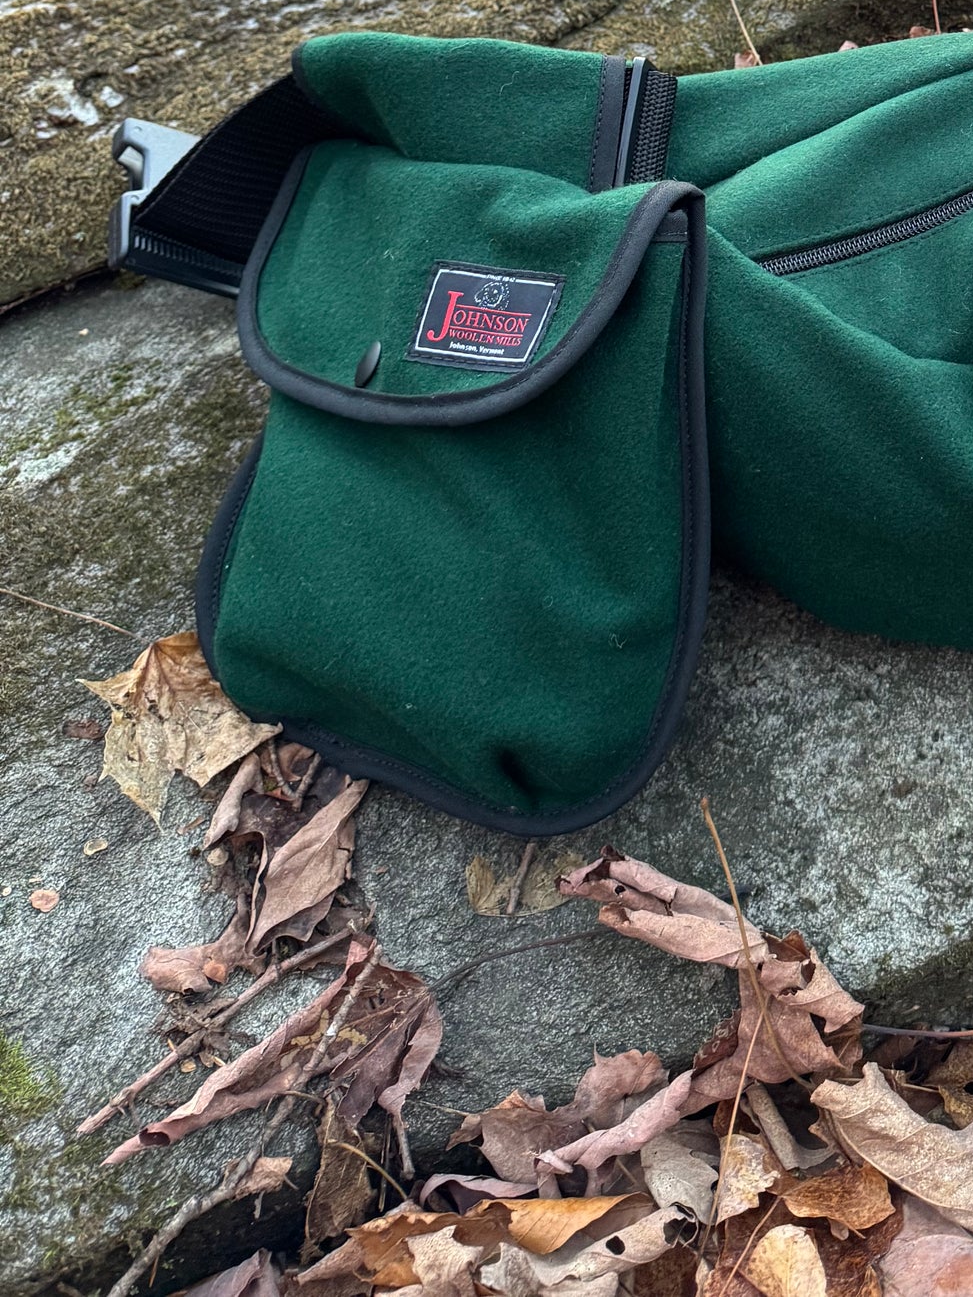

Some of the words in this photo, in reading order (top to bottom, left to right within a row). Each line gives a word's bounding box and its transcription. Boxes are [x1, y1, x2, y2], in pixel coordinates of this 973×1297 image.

[426, 290, 530, 342] JOHNSON
[449, 329, 495, 344] WOOLEN
[496, 336, 523, 347] MILLS
[448, 341, 478, 353] Johnson,
[479, 345, 505, 355] Vermont
